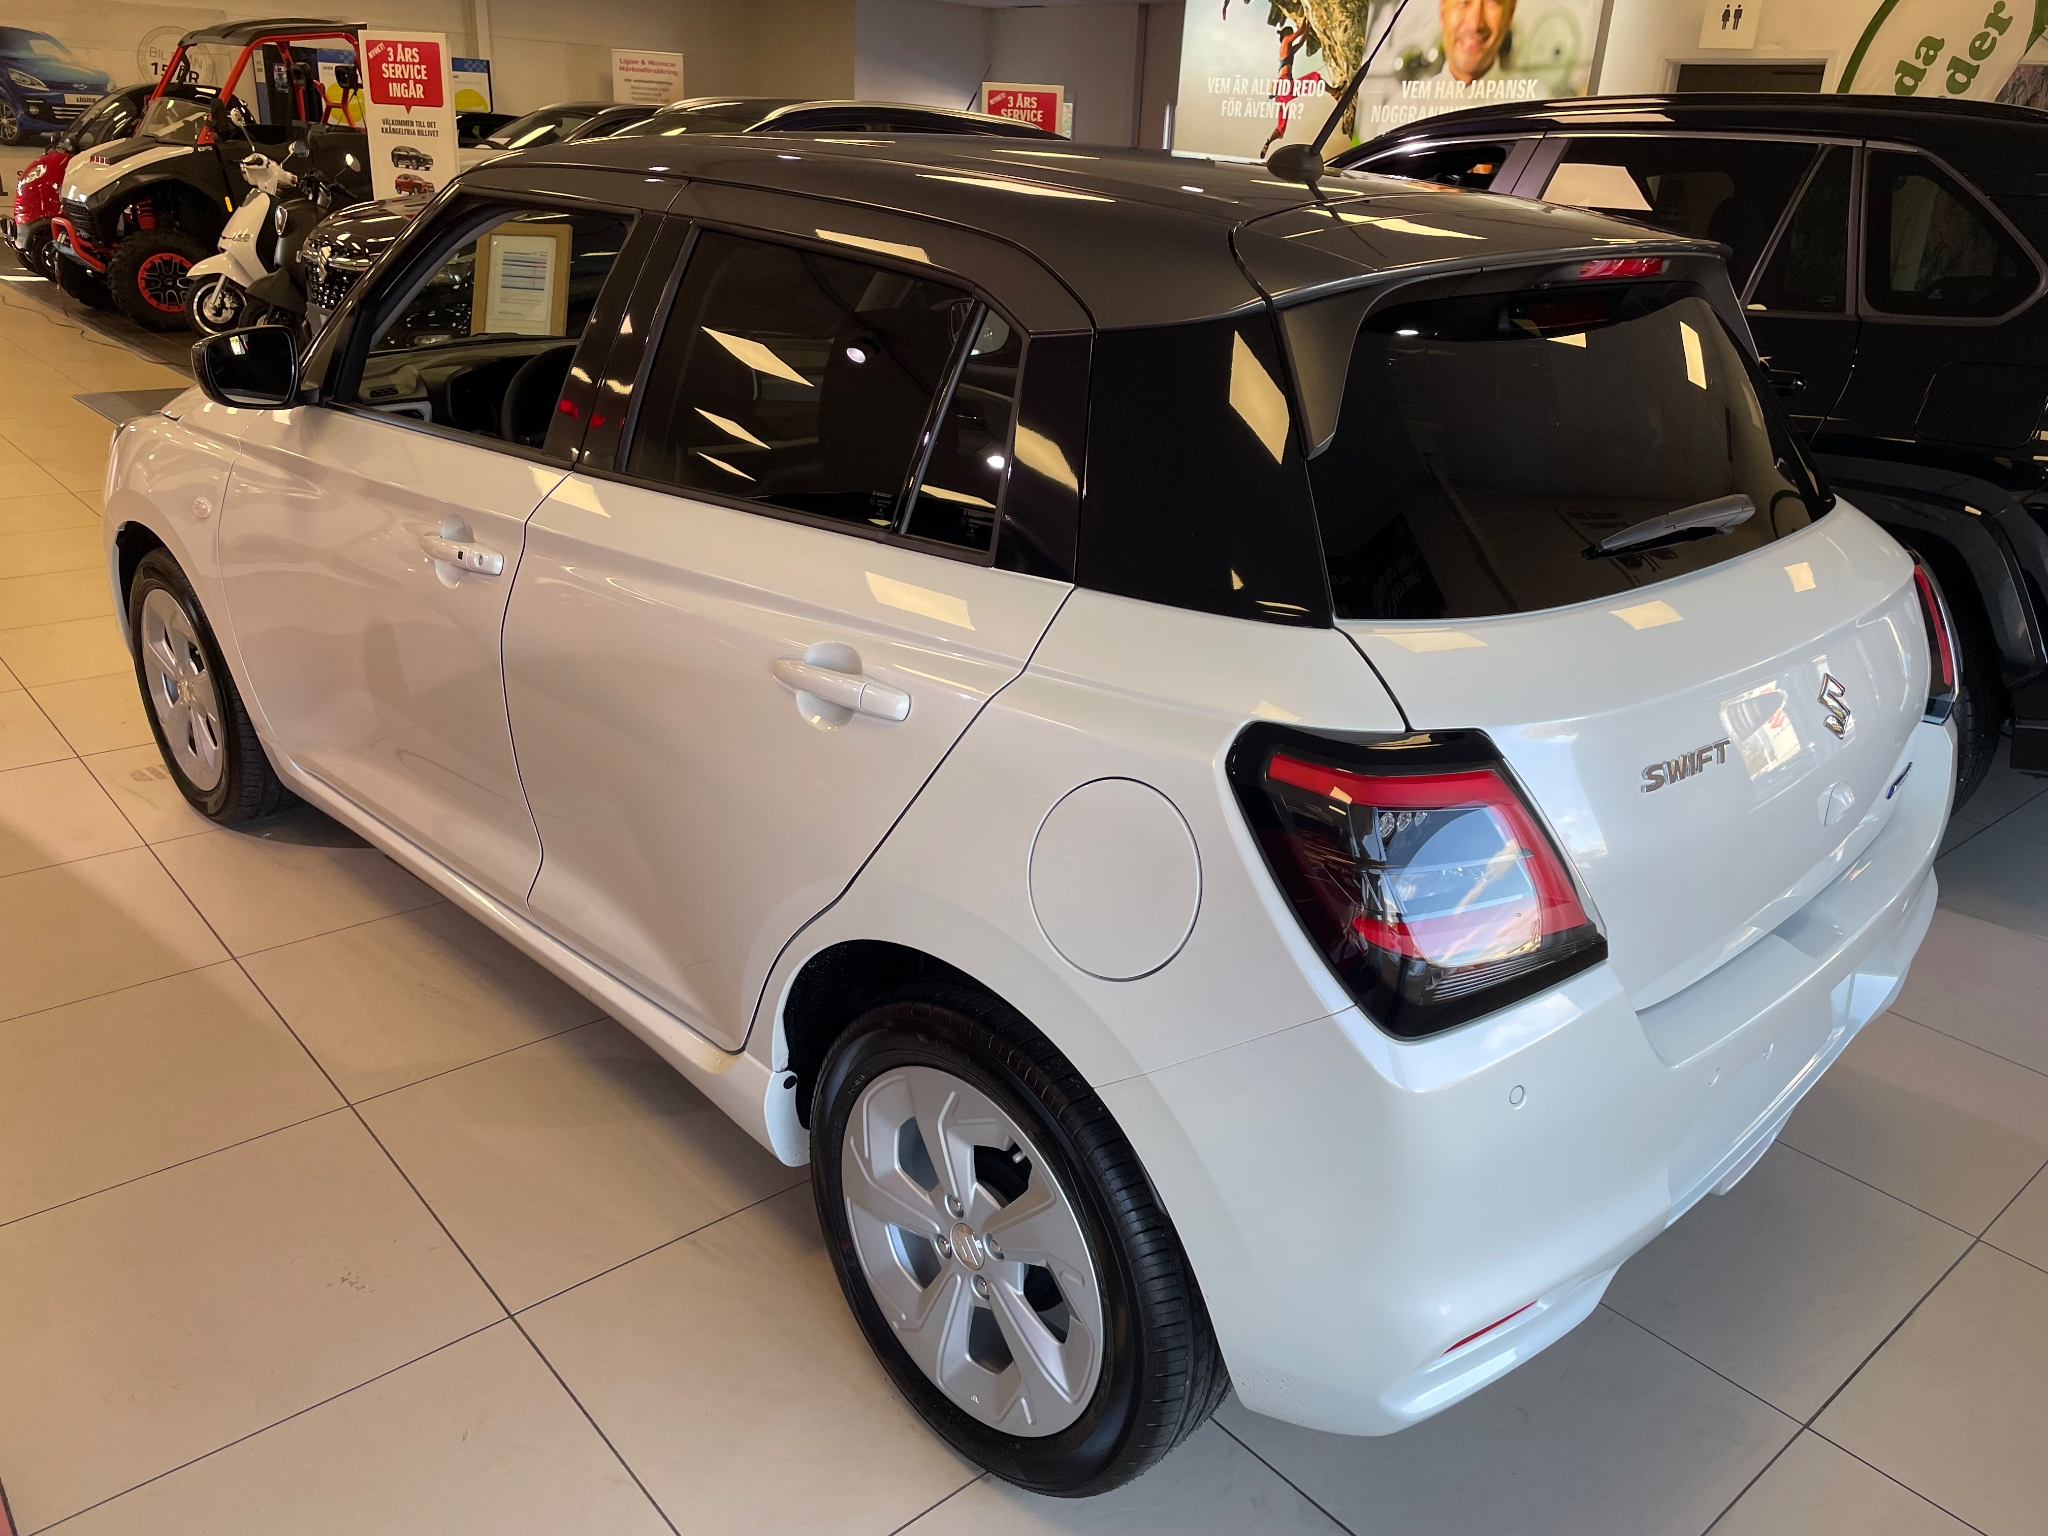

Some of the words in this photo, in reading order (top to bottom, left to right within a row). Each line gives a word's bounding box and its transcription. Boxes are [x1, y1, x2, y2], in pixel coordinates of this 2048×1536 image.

[149, 46, 167, 61] BIL
[387, 47, 395, 62] 3
[397, 43, 420, 63] ÅRS
[1938, 1, 2014, 98] der
[619, 58, 639, 66] Ligier
[381, 63, 428, 80] SERVICE
[388, 80, 425, 99] INGÅR
[1207, 76, 1230, 94] VEM
[1232, 74, 1249, 95] ÄR
[1250, 78, 1292, 97] ALLTID
[1292, 79, 1326, 97] REDO
[1402, 80, 1431, 99] VEM
[1434, 80, 1466, 99] HAR
[1467, 79, 1539, 99] JAPANSK
[1007, 96, 1014, 108] 3
[1015, 93, 1038, 109] ÅRS
[1220, 97, 1242, 117] FÖR
[1244, 97, 1305, 120] ÄVENTYR?
[382, 117, 414, 127] VÄLKOMMEN
[415, 120, 426, 128] TILL
[427, 121, 437, 129] DET
[1000, 108, 1044, 122] SERVICE
[381, 126, 416, 136] KRÅNGELFRIA
[417, 129, 439, 138] BILLIVET
[1640, 737, 1732, 794] SWIFT
